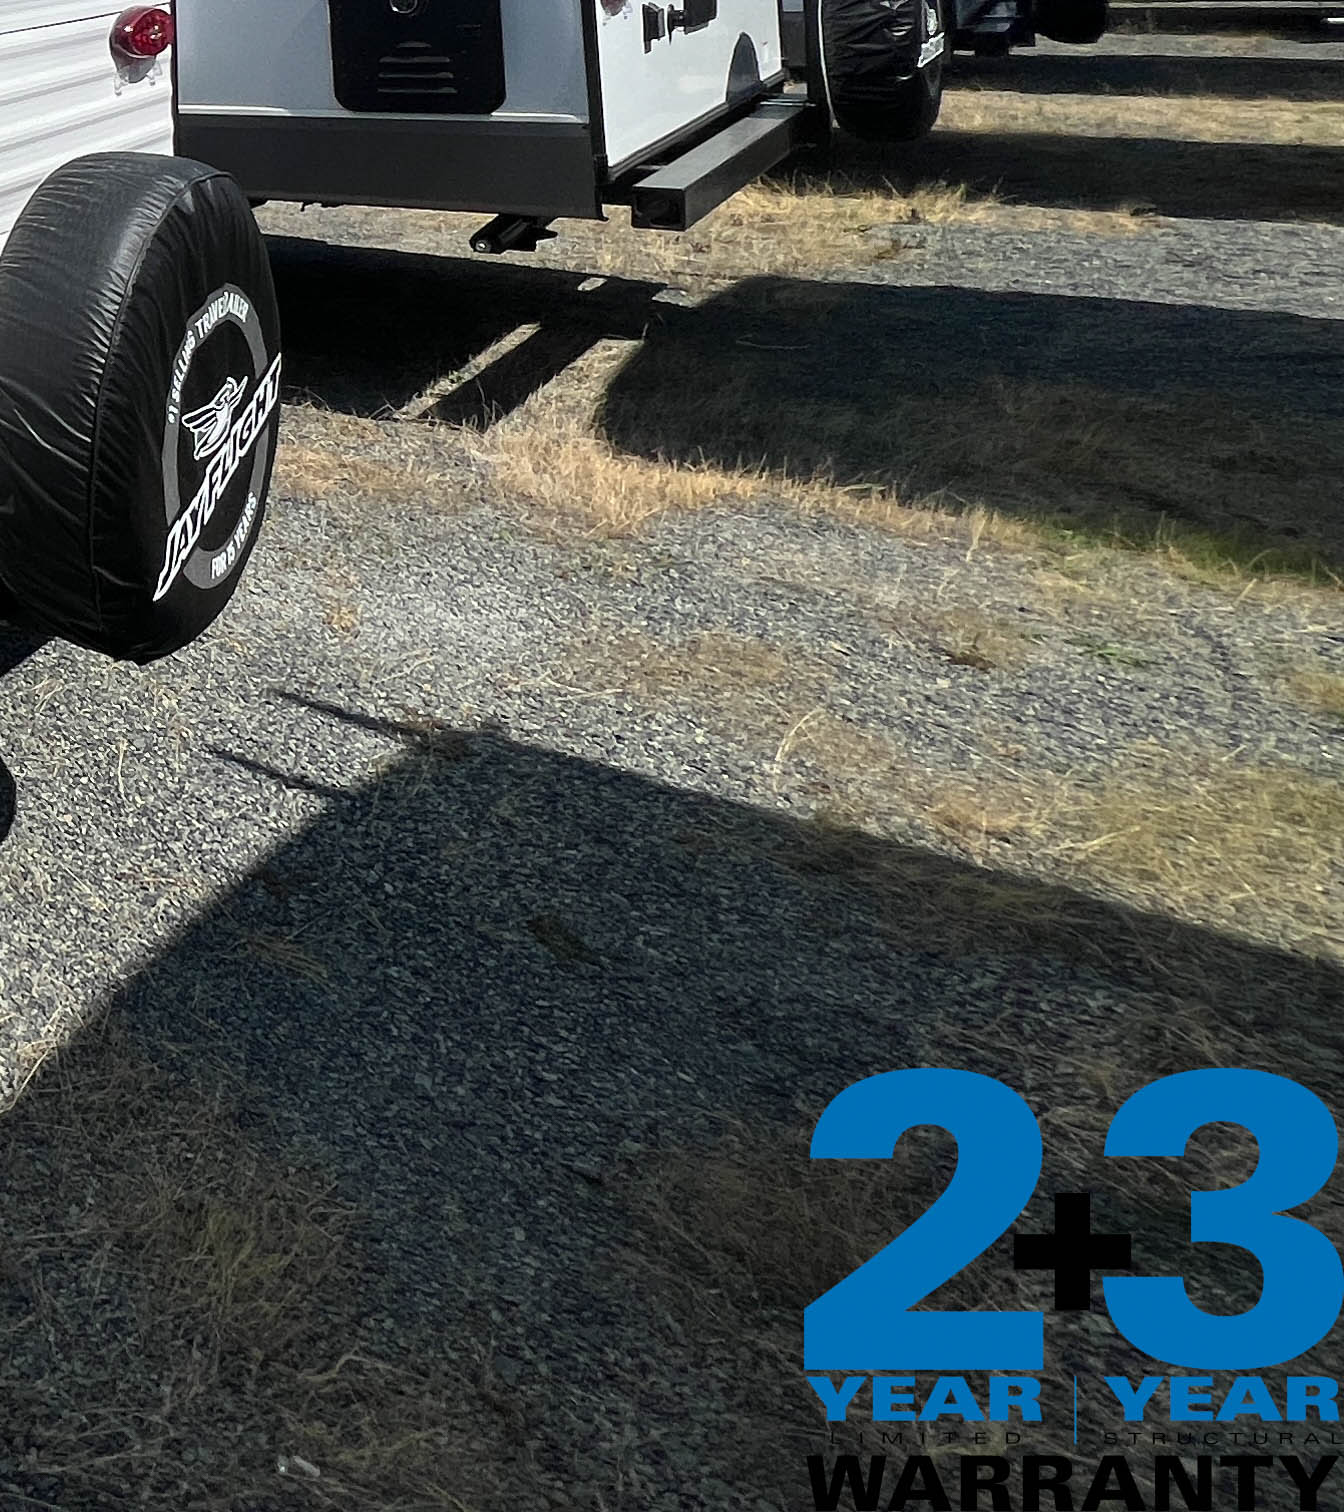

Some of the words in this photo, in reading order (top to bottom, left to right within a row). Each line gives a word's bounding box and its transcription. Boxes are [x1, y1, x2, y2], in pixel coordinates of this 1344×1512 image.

[153, 485, 205, 601] JAY
[203, 352, 281, 525] FLIGHT
[234, 491, 257, 549] YEARS
